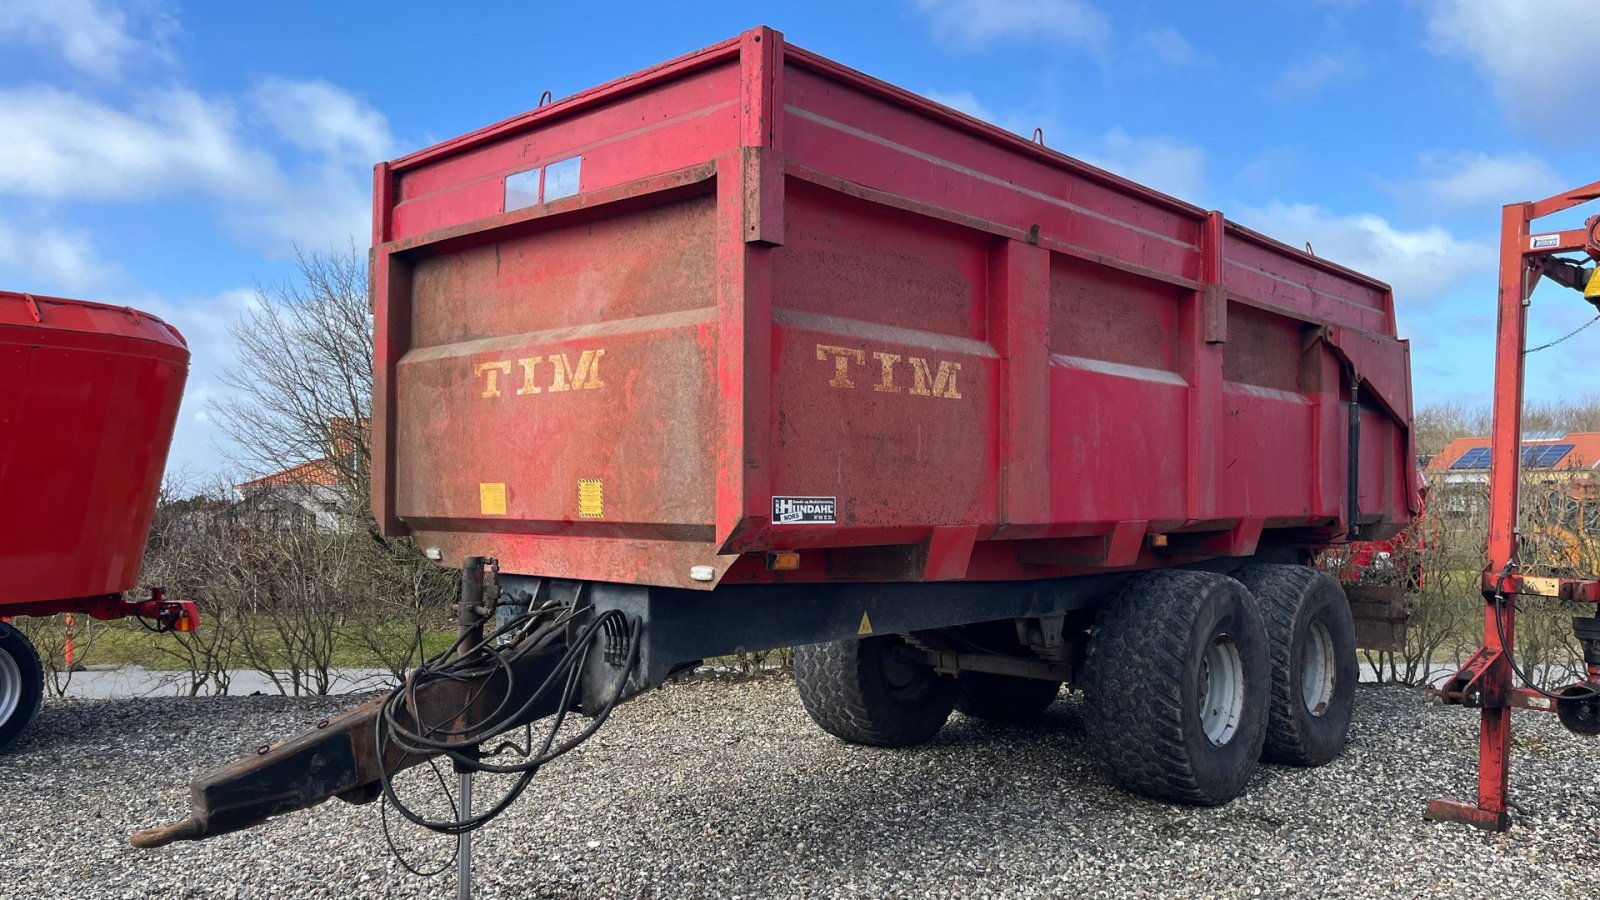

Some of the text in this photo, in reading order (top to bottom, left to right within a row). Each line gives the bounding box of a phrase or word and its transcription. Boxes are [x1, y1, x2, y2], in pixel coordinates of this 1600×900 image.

[473, 348, 605, 399] TIM
[816, 344, 962, 399] TIM
[780, 499, 834, 514] HUNDAHL
[784, 513, 800, 521] NORS
